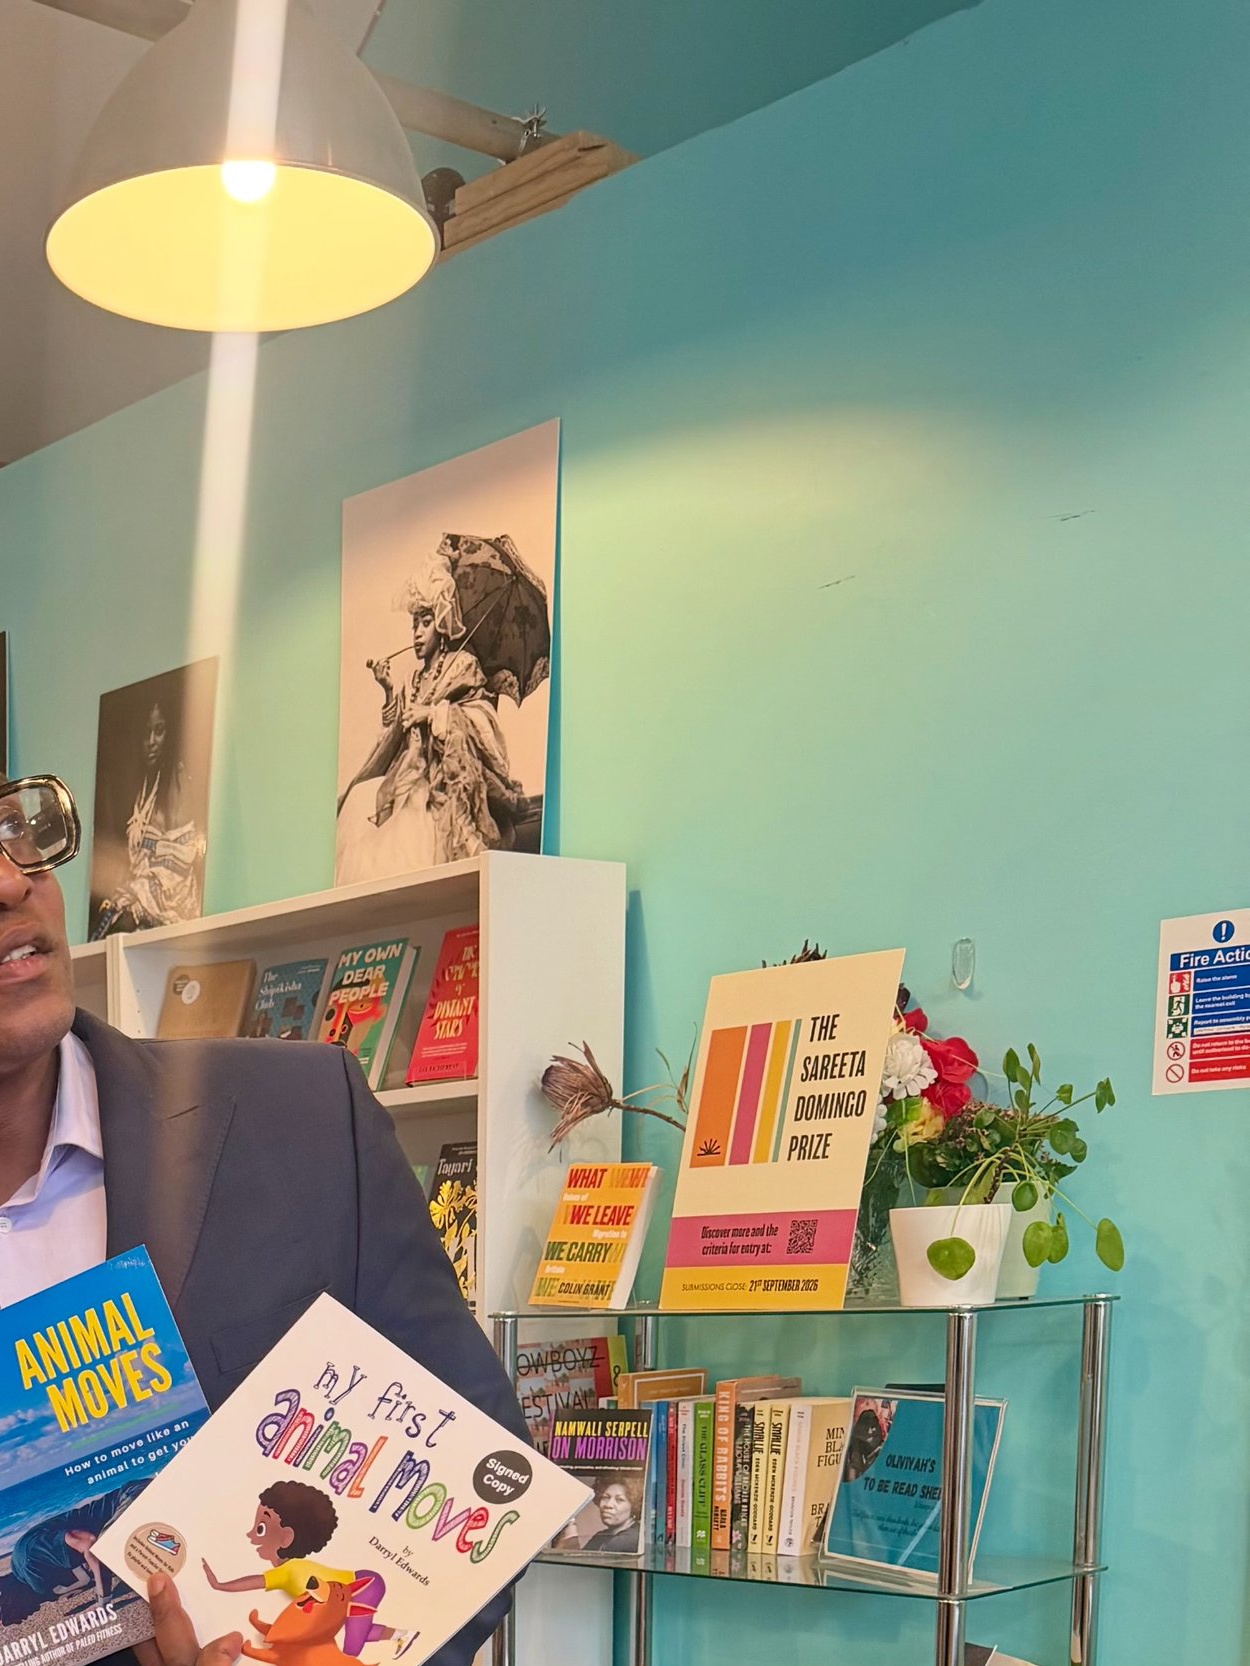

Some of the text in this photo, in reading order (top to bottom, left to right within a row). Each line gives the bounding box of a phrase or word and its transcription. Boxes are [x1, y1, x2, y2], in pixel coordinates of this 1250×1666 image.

[338, 943, 403, 968] MY OWN
[1179, 953, 1210, 968] Fire
[342, 964, 386, 986] DEAR
[328, 982, 389, 1006] PEOPLE
[810, 1014, 840, 1042] THE
[800, 1050, 866, 1082] SAREETA
[794, 1090, 867, 1122] DOMINGO
[787, 1133, 832, 1162] PRIZE
[567, 1168, 607, 1189] WHAT
[570, 1205, 634, 1226] WE LEAVE
[701, 1224, 778, 1239] Discover more and the
[544, 1241, 613, 1263] WE CARRY
[701, 1242, 728, 1256] criteria
[728, 1242, 740, 1255] for
[740, 1243, 760, 1257] entry
[557, 1282, 610, 1296] COLIN GRANT
[682, 1282, 724, 1291] SUBMISSIONS
[762, 1280, 800, 1291] SEPTEMBER
[800, 1279, 819, 1291] 2026
[15, 1292, 156, 1391] ANIMAL
[46, 1342, 173, 1433] MOVES
[313, 1361, 457, 1449] my first
[554, 1421, 648, 1437] NAMWALI SERPELL
[64, 1420, 190, 1477] How to move like an
[255, 1388, 389, 1499] animal
[551, 1436, 647, 1461] ON MORRISON
[714, 1391, 731, 1502] KING OF RABBITS
[87, 1445, 169, 1485] animal to get
[485, 1457, 530, 1486] Signed
[698, 1442, 708, 1476] GLASS
[885, 1454, 936, 1473] OLIVIYAH'S
[482, 1474, 515, 1497] Copy
[698, 1478, 708, 1506] CLIFF
[863, 1477, 875, 1491] TO
[877, 1480, 890, 1493] BE
[892, 1481, 918, 1497] READ
[368, 1535, 431, 1588] Darryl Edwards
[402, 1546, 414, 1558] by
[48, 1603, 118, 1644] EDWARDS
[41, 1646, 67, 1664] AUTHOR
[66, 1643, 75, 1654] OF
[75, 1634, 96, 1651] PALEO
[96, 1623, 123, 1642] FITNESS
